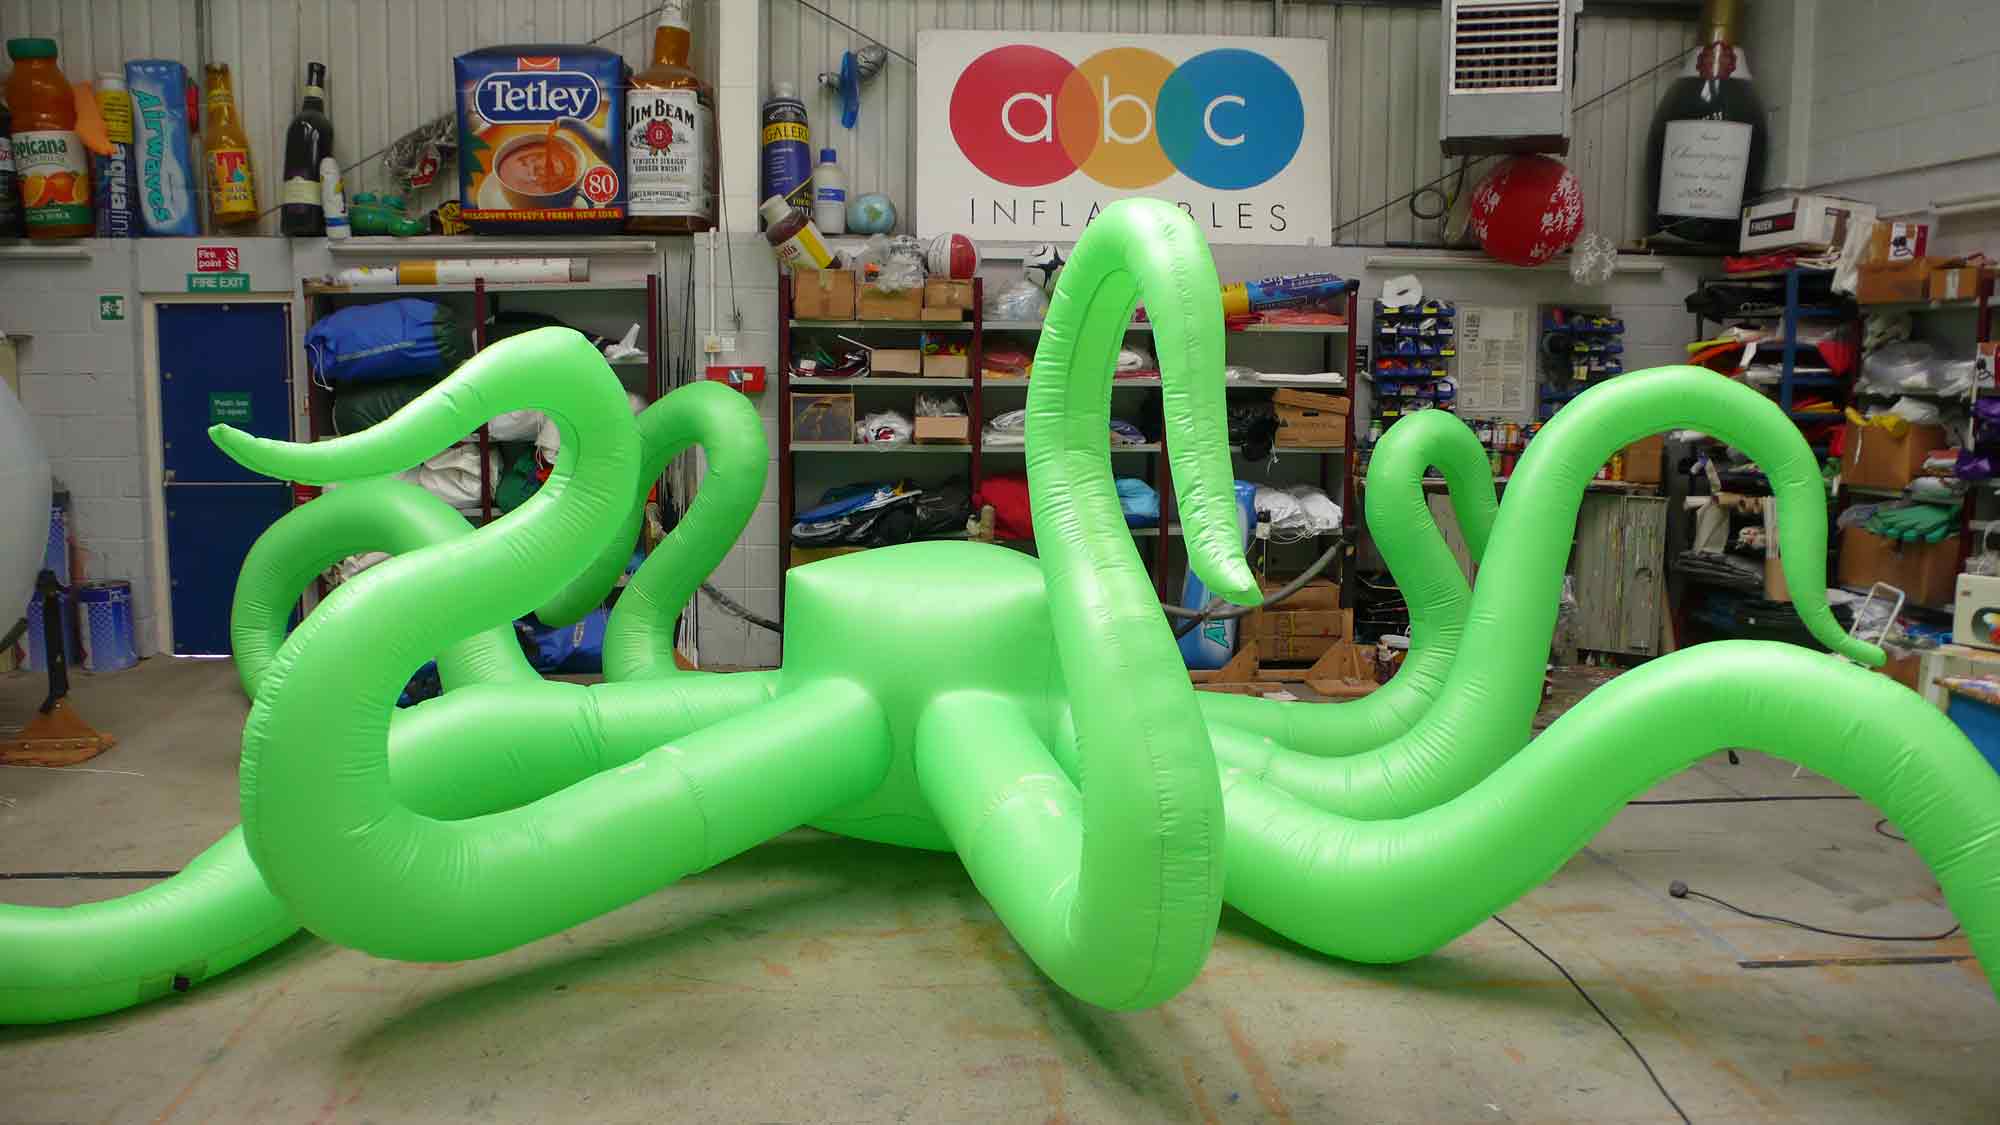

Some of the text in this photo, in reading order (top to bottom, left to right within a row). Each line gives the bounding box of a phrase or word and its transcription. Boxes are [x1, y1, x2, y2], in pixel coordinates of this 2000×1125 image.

[487, 80, 592, 117] Tetley
[627, 98, 695, 131] JIM BEAM
[589, 174, 615, 194] 80
[970, 198, 1287, 232] INFLALES
[199, 249, 217, 258] Fire
[199, 259, 222, 270] point
[192, 277, 244, 288] FIRE EXIT
